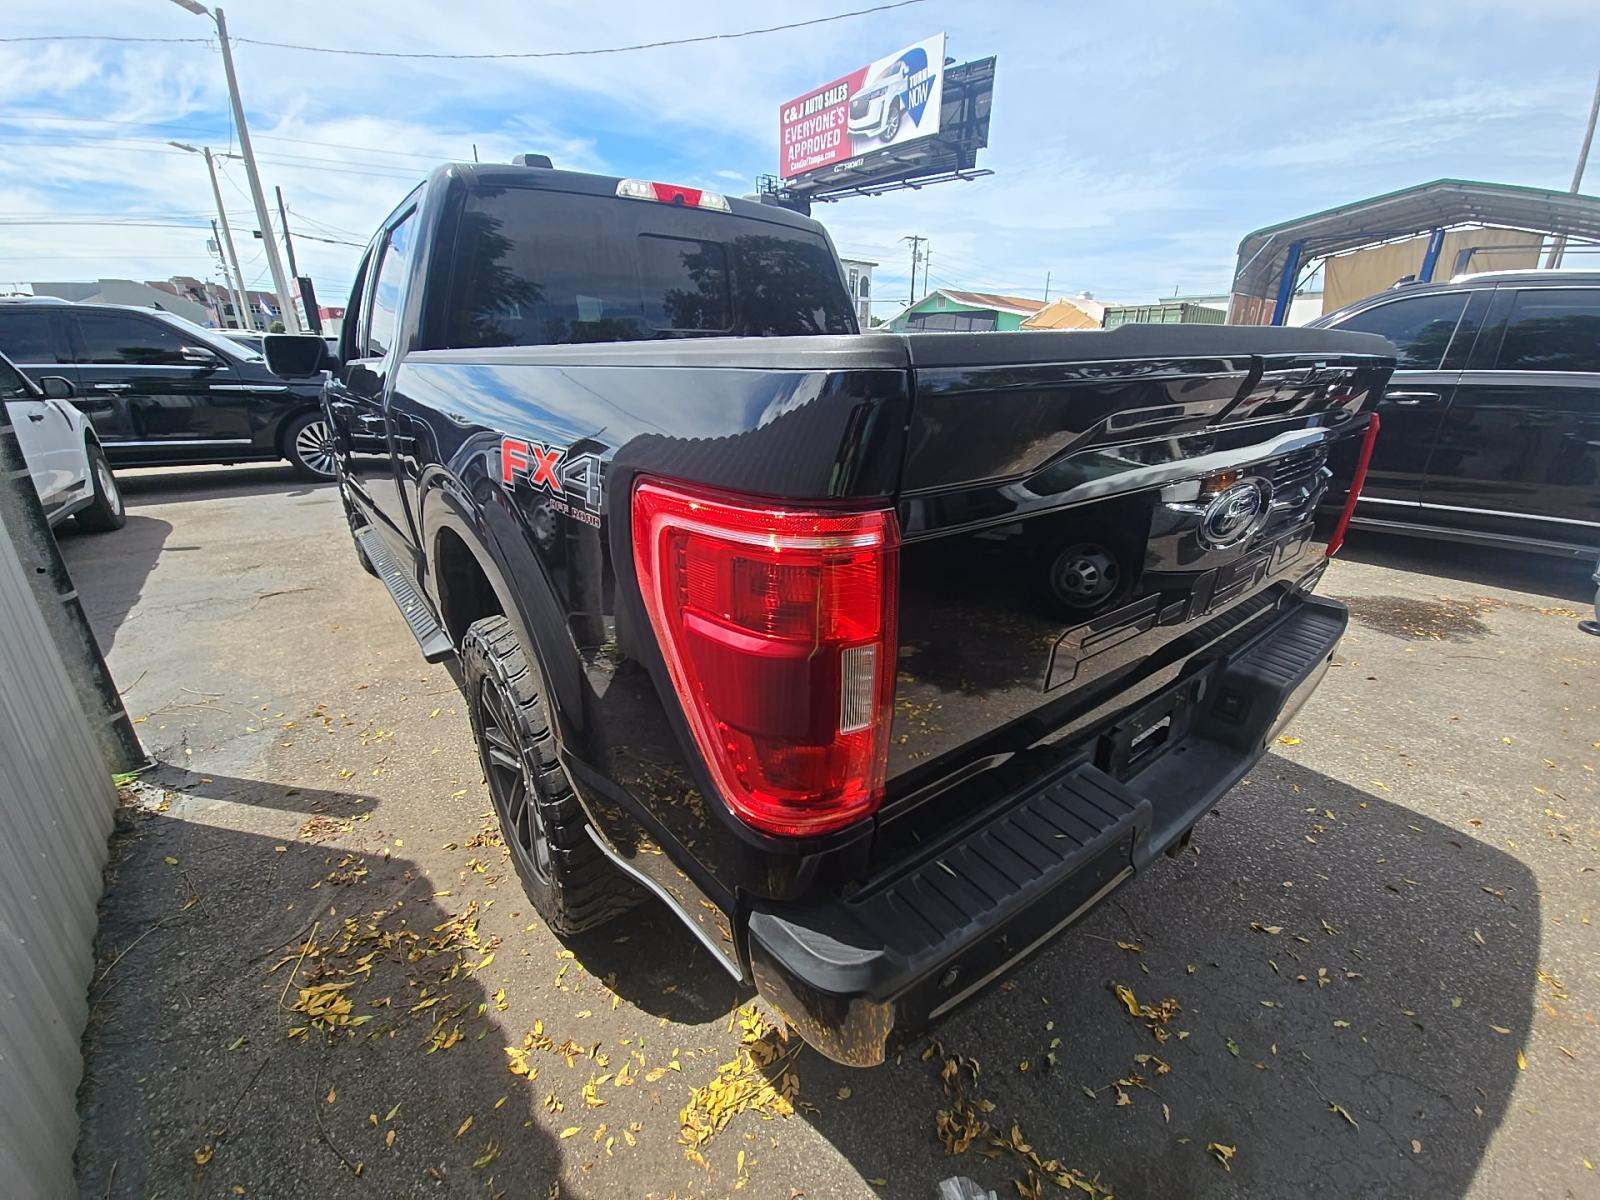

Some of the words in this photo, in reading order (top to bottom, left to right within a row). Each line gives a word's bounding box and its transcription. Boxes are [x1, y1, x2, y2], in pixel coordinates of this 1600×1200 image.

[804, 93, 824, 116] AUTO
[824, 82, 849, 108] SALES
[908, 80, 928, 111] NOW
[785, 106, 845, 145] EVERYONE'S
[788, 128, 841, 163] APPROVED
[500, 434, 602, 515] FX4
[1042, 520, 1315, 694] F-150
